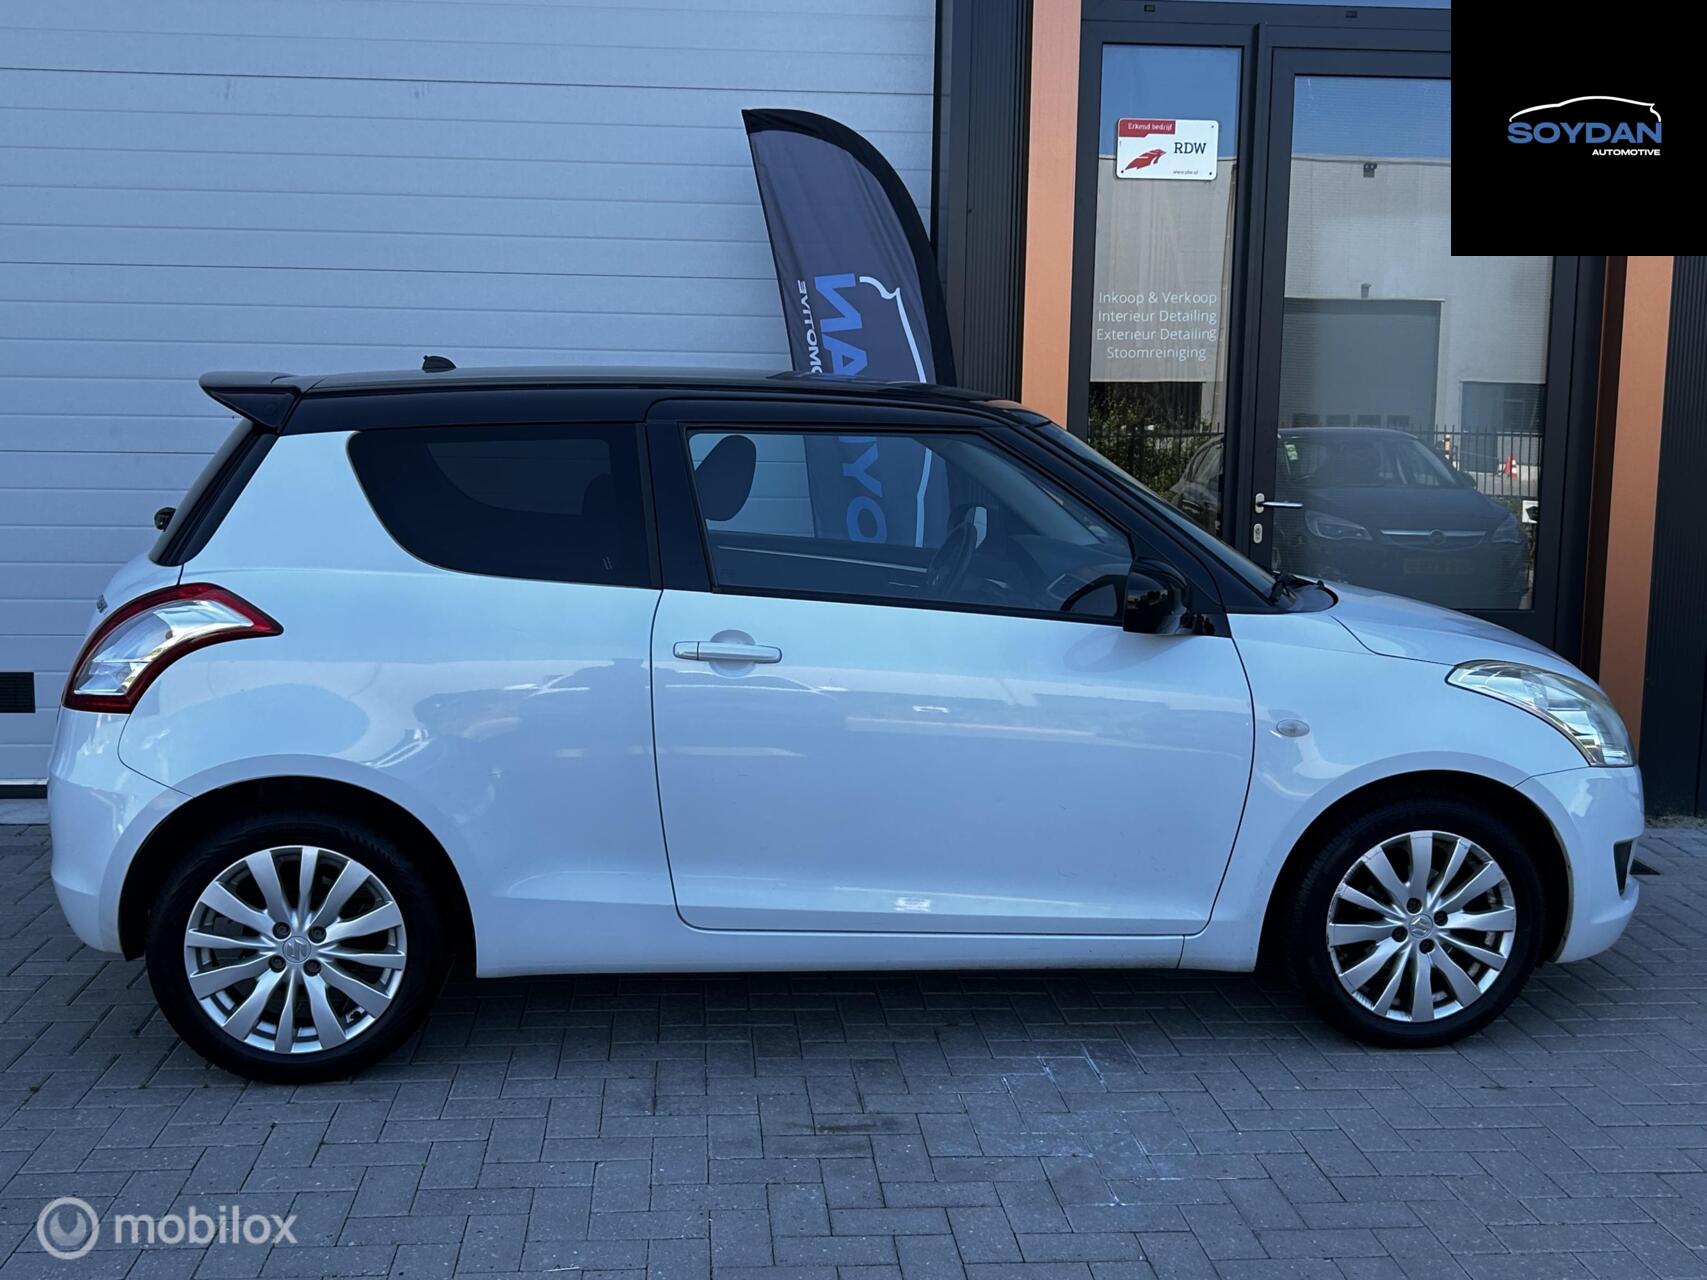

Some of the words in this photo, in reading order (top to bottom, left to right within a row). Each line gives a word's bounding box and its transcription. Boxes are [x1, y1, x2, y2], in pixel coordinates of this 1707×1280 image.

[1174, 142, 1206, 154] RDW
[1099, 292, 1144, 306] Inkoop
[1148, 291, 1158, 304] &
[1161, 292, 1217, 306] Verkoop
[1098, 310, 1155, 322] Interieur
[1160, 310, 1217, 325] Detailing
[1096, 328, 1156, 341] Exterieur
[1160, 328, 1217, 342] Detailing
[1106, 346, 1206, 361] Stoomreiniging
